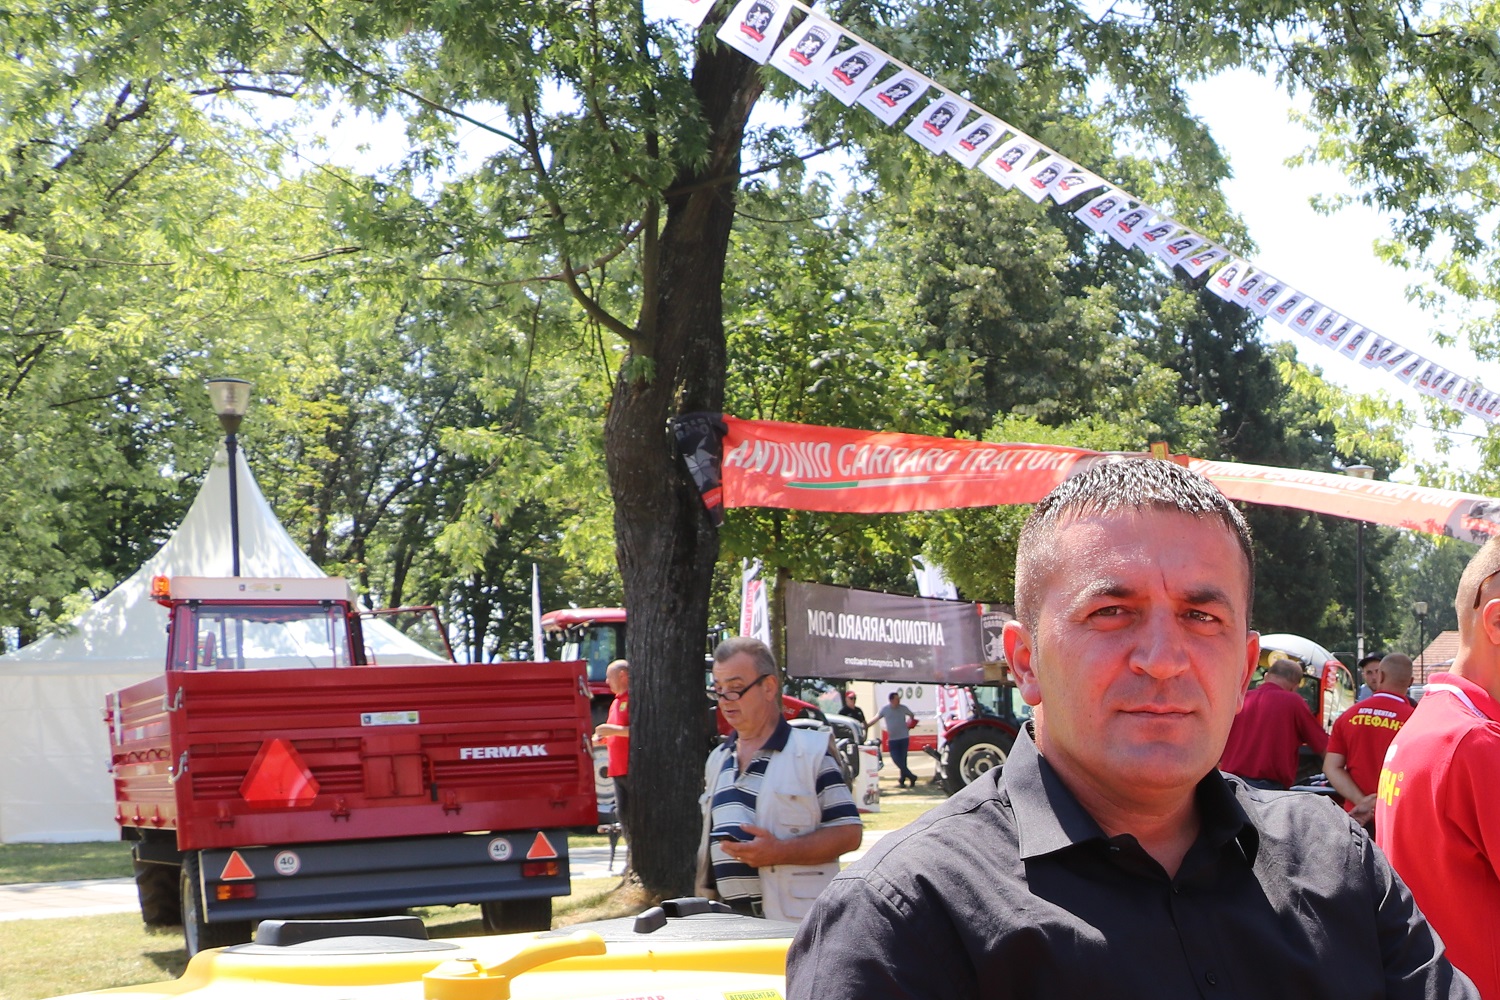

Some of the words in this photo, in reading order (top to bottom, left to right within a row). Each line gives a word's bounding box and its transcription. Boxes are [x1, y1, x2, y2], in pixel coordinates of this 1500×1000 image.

[724, 439, 831, 478] ANTONIO
[837, 444, 959, 476] CARRARO
[960, 448, 1077, 471] TRATTORI
[460, 744, 548, 760] FERMAK
[493, 843, 507, 853] 40
[279, 856, 294, 866] 40
